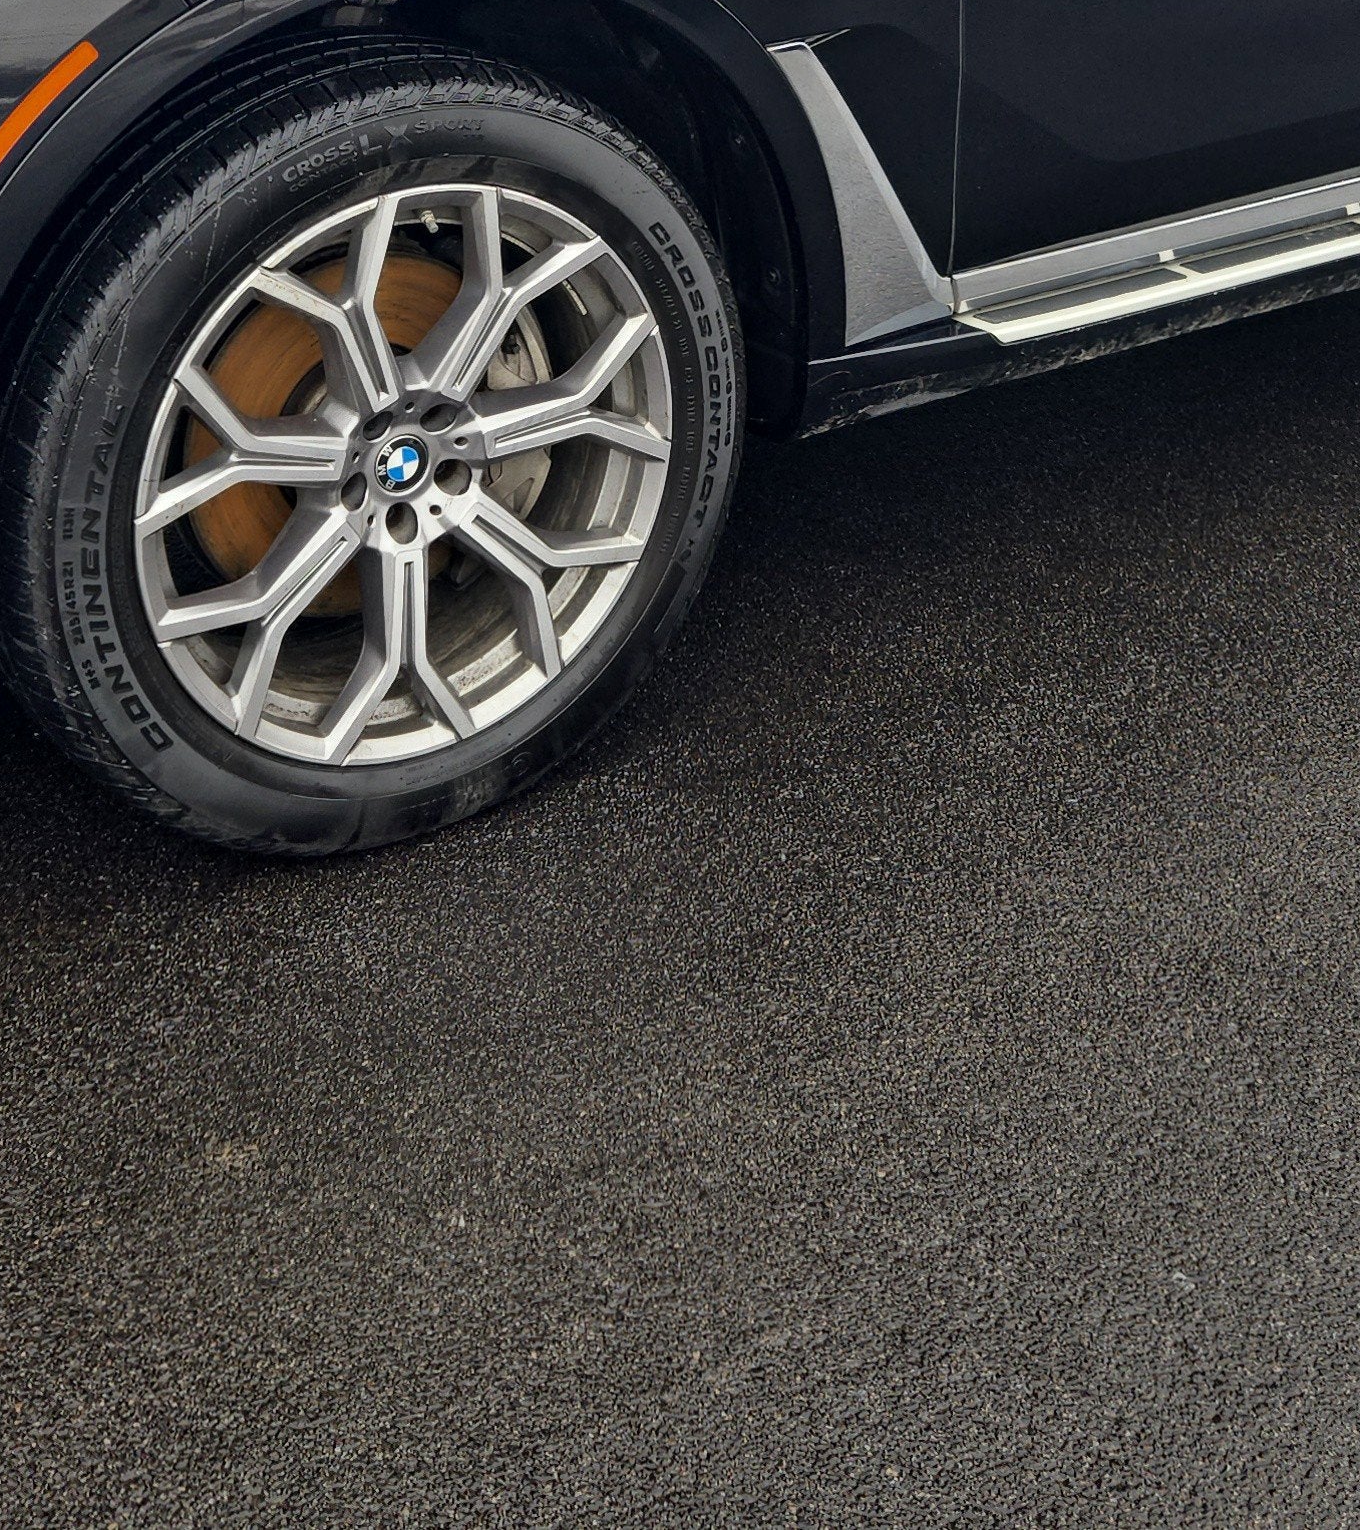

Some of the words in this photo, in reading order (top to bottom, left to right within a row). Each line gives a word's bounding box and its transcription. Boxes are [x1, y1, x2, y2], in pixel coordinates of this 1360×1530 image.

[281, 139, 355, 184] CROSS
[414, 119, 485, 135] SPORT
[377, 444, 397, 490] BMW
[648, 222, 713, 338] CROSS
[693, 345, 722, 529] CONTACT
[80, 402, 175, 753] CONTINENTAL
